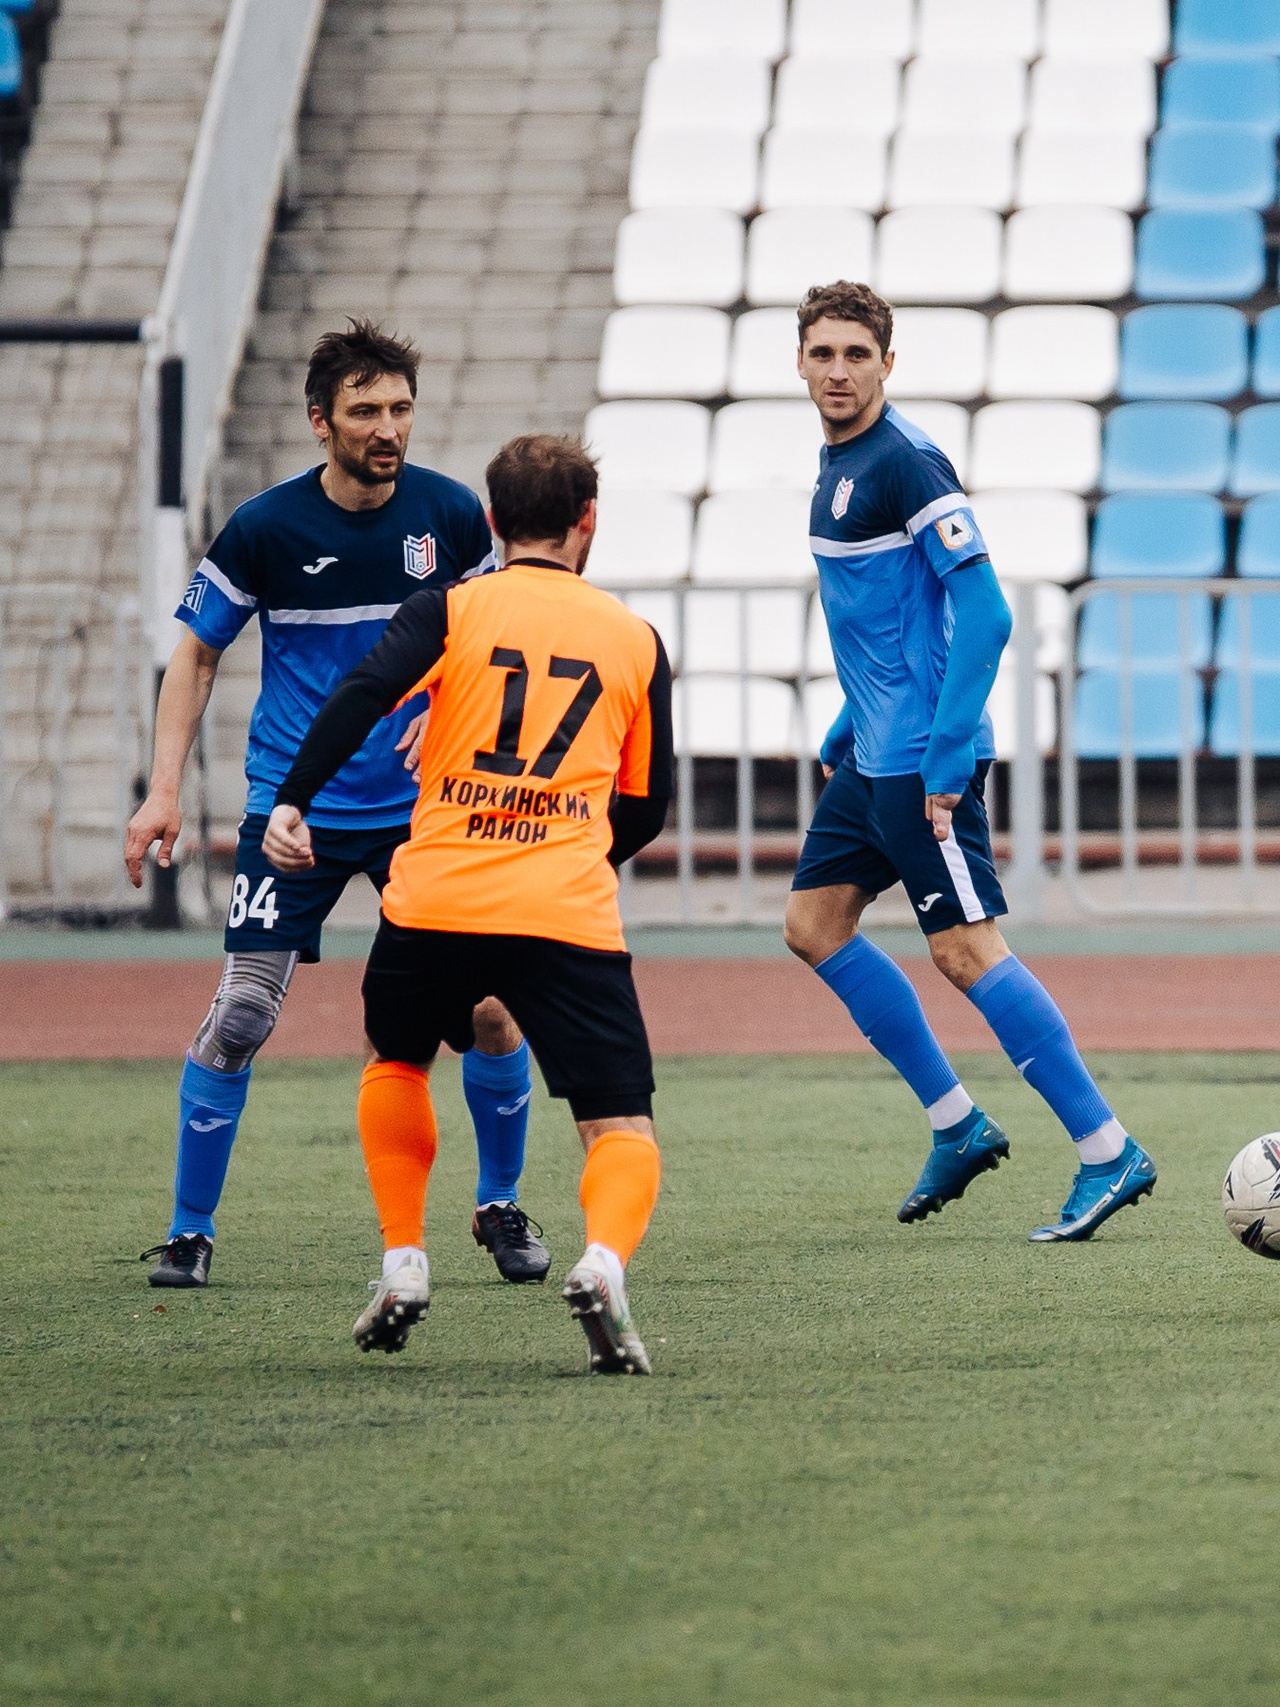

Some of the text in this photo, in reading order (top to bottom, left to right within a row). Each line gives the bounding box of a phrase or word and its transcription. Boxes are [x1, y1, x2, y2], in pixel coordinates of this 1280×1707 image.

[472, 646, 604, 780] 17
[465, 814, 548, 845] РАЙОН
[228, 873, 280, 929] 84
